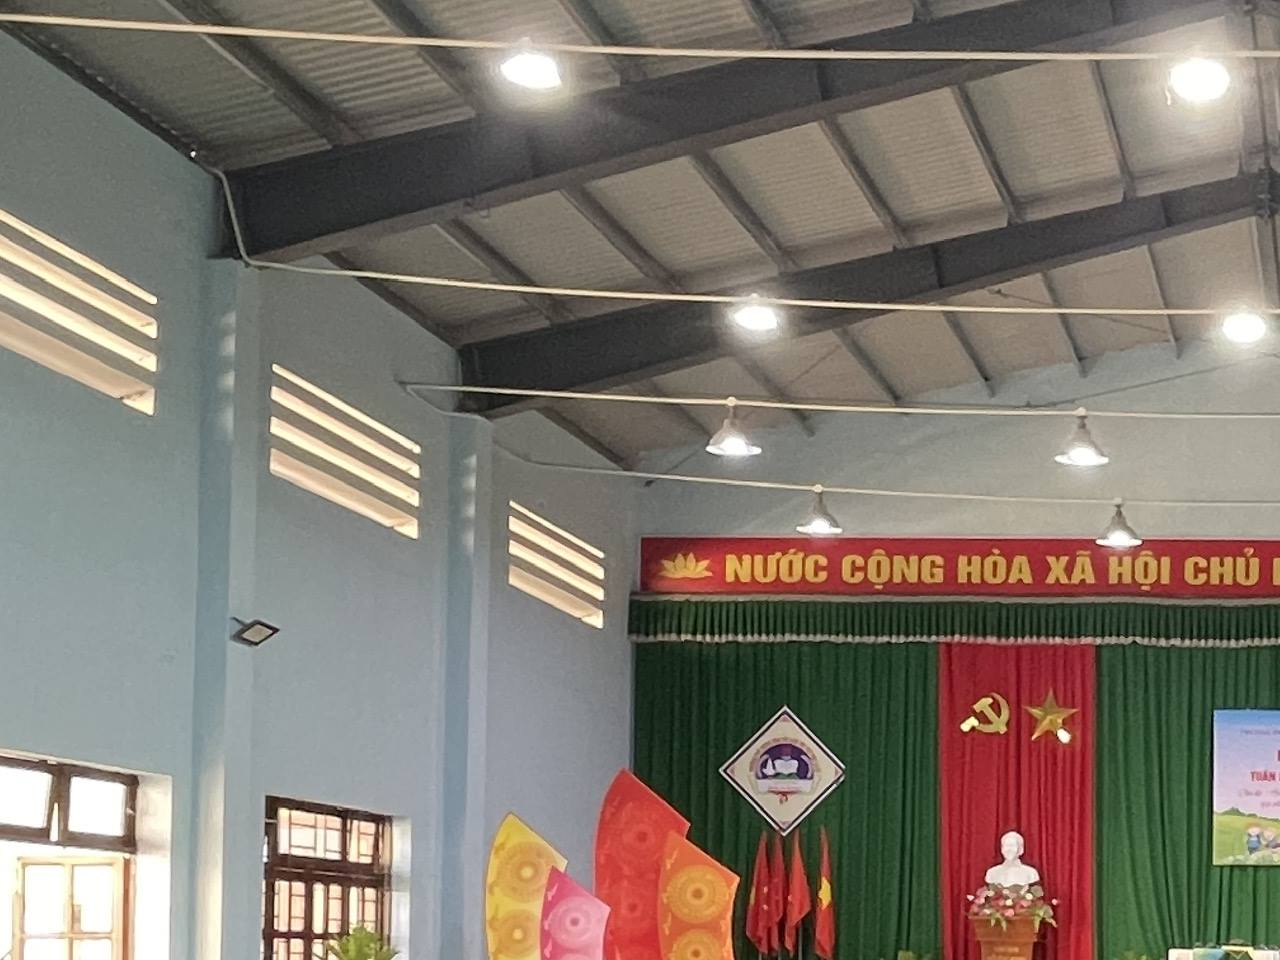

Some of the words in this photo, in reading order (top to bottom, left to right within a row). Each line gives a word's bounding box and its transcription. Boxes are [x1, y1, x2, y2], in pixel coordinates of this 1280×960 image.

[725, 551, 829, 584] NƯỚC
[841, 549, 945, 590] CỘNG
[957, 549, 1033, 584] HÒA
[1045, 550, 1096, 585] XÃ
[1108, 549, 1171, 591] HỘI
[1183, 548, 1260, 585] CHỦ
